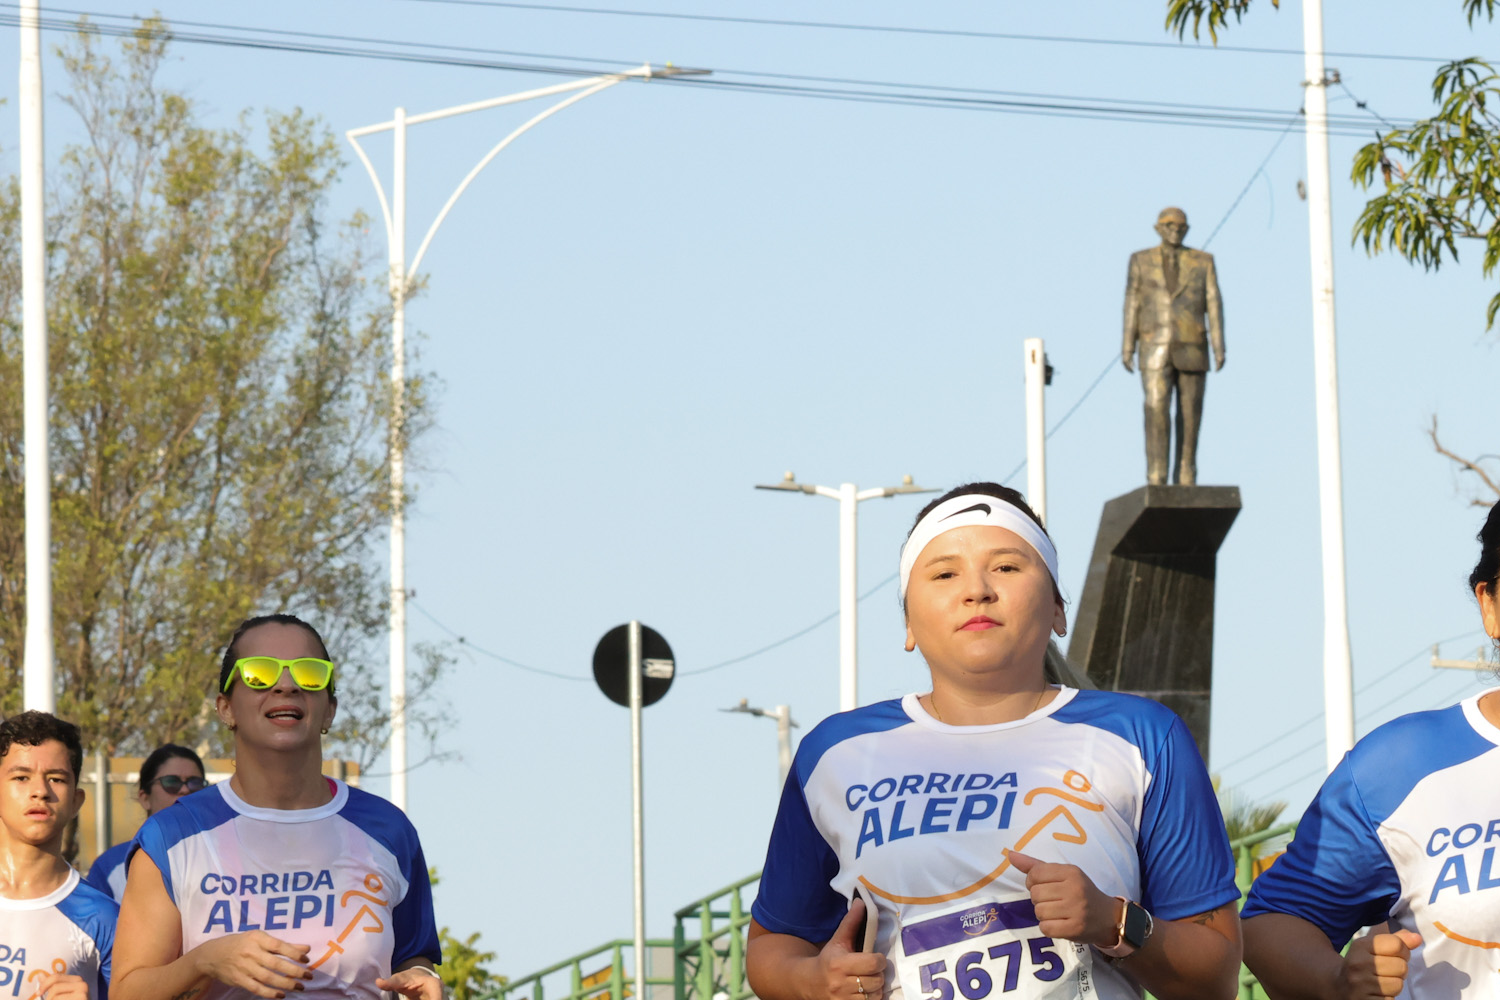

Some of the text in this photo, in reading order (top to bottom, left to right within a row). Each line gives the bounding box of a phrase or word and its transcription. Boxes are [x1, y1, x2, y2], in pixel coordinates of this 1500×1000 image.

[845, 771, 1019, 812] CORRIDA
[855, 790, 1018, 861] ALEPI
[200, 869, 335, 897] CORRIDA
[202, 894, 336, 934] ALEPI
[962, 914, 987, 929] ALEPI
[1080, 970, 1090, 993] 5675
